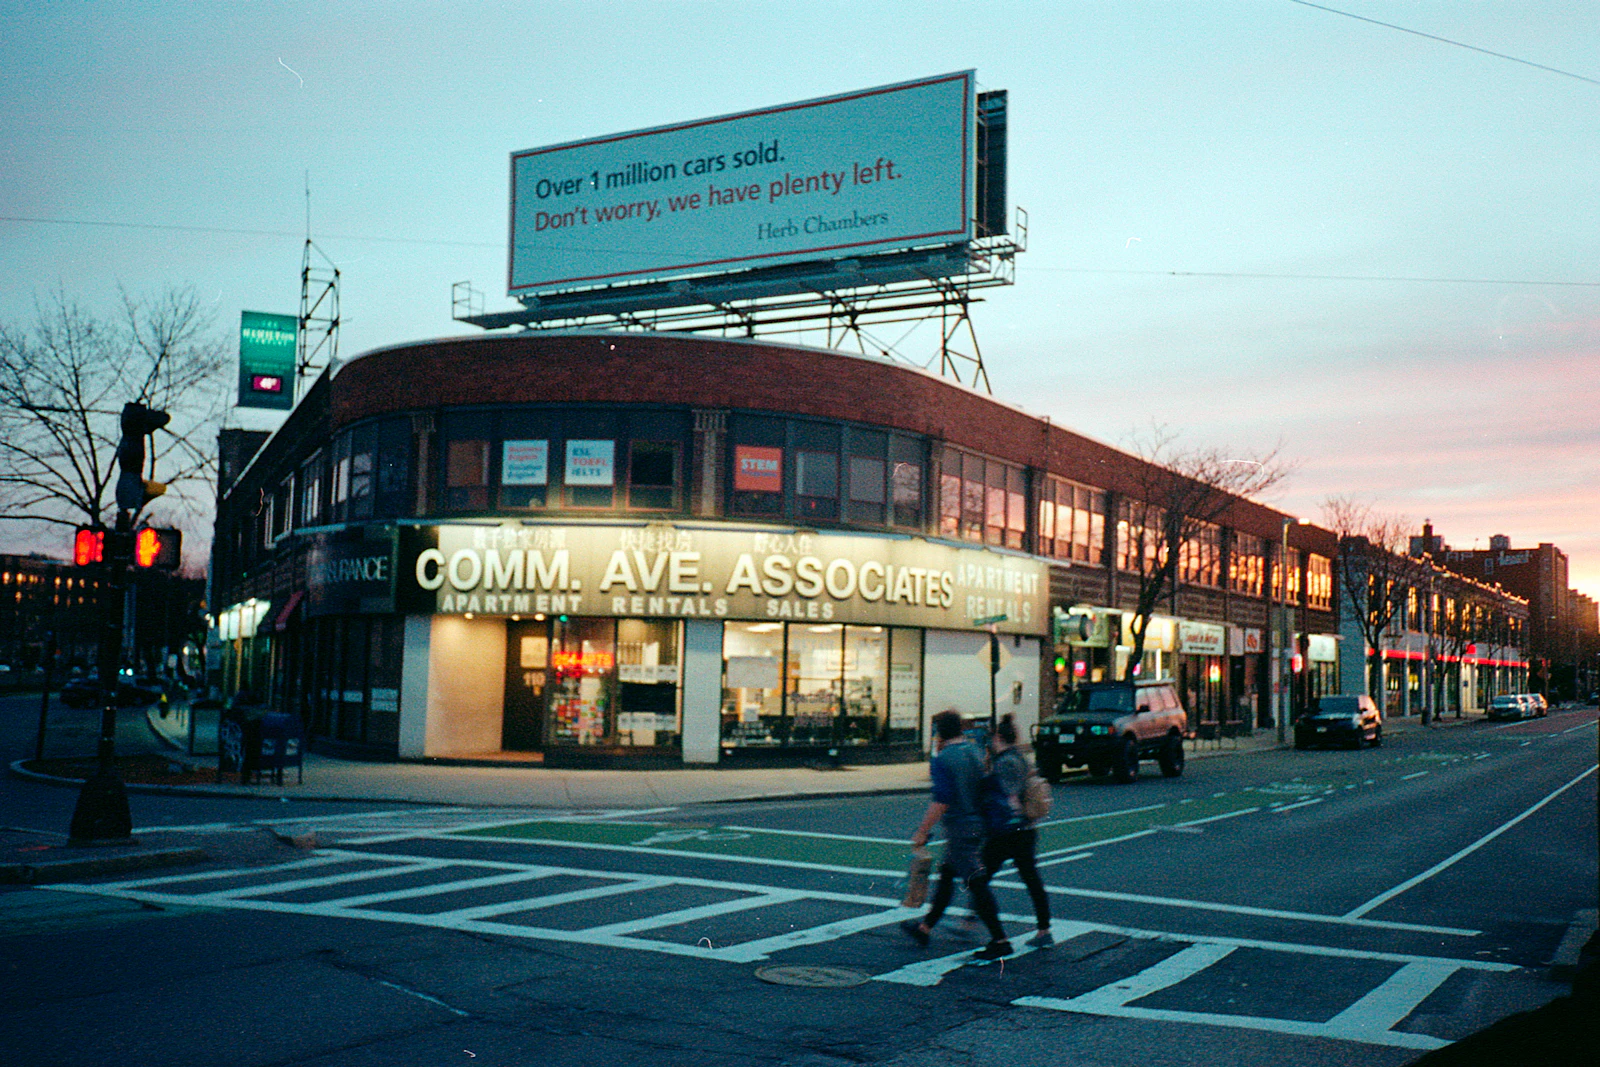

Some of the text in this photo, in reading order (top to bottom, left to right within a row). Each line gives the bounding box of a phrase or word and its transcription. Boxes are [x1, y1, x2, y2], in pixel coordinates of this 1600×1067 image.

[535, 139, 786, 199] Over 1 million cars sold.
[535, 157, 902, 231] Don't worry, we have plenty left.
[757, 210, 889, 240] Herb Chambers
[572, 457, 608, 466] TOEFL
[741, 458, 778, 471] STEM
[416, 548, 954, 608] COMM. AVE. ASSOCIATES
[956, 563, 1039, 595] APARTMENT
[442, 593, 834, 619] APARTMENT RENTALS SALES
[966, 595, 1032, 624] RENTALS
